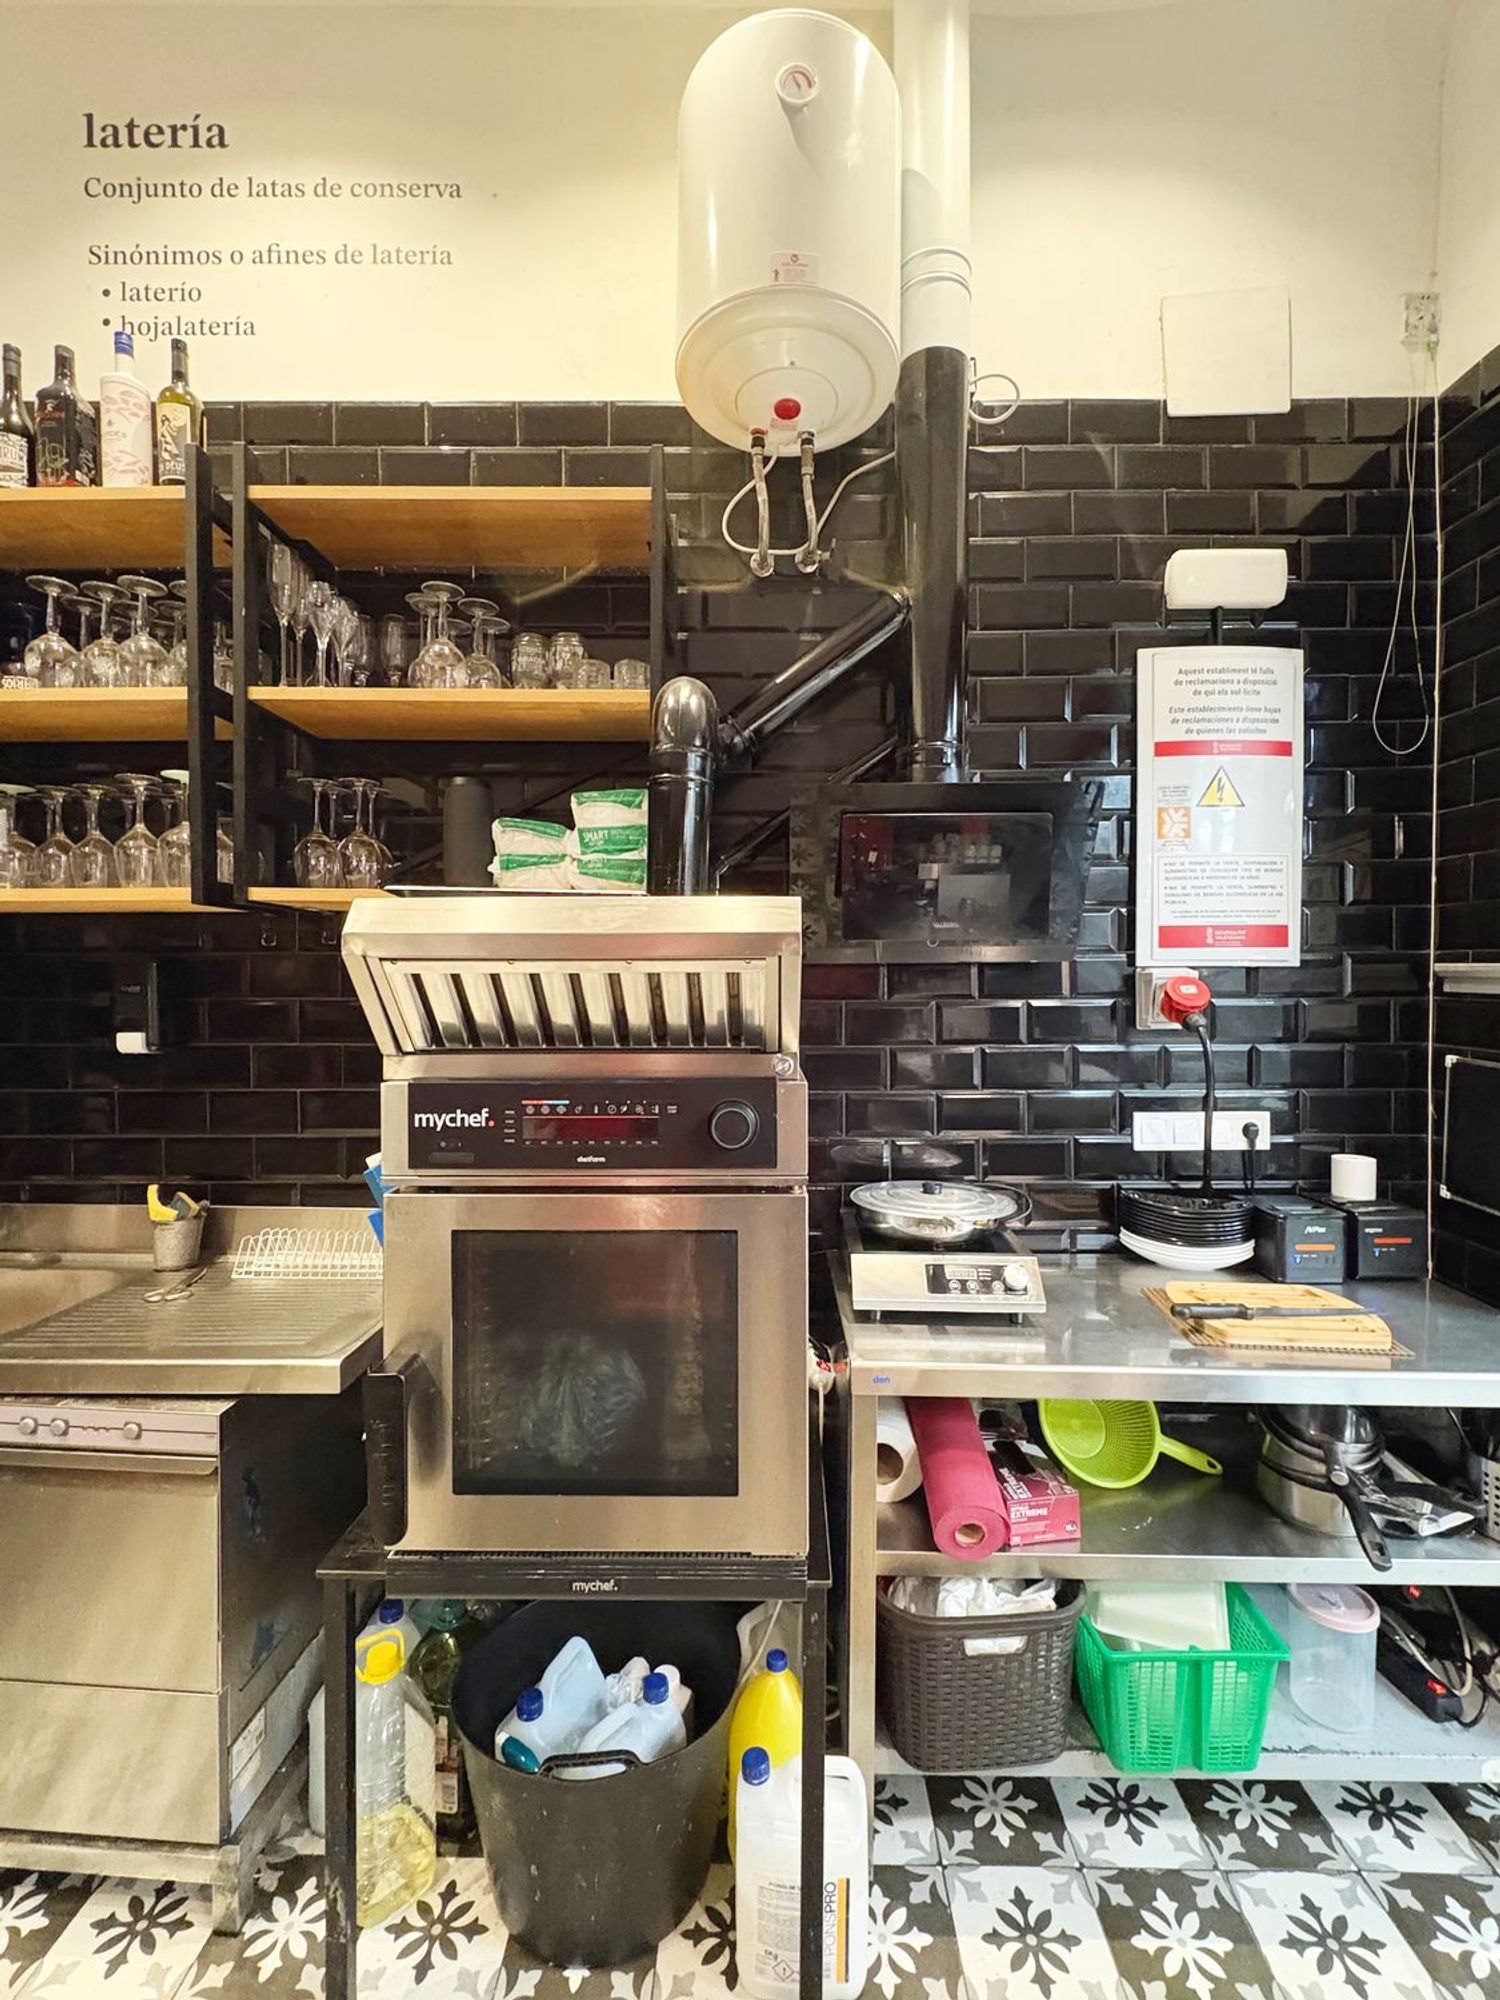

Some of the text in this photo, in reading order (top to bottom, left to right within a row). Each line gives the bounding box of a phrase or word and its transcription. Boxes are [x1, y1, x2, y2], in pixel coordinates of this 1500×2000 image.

[82, 112, 230, 150] latería
[83, 176, 463, 205] Conjunto de latas de conserva
[87, 242, 453, 266] Sinónimos o afines de latería
[119, 280, 202, 303] laterío
[119, 314, 256, 343] hojalatería
[1177, 667, 1205, 677] Aquest
[1173, 678, 1184, 687] de
[1185, 677, 1235, 686] reclamacions
[1192, 688, 1202, 697] de
[1168, 705, 1185, 715] Este
[1170, 716, 1179, 725] de
[1184, 726, 1195, 735] de
[414, 1108, 495, 1132] mychef.
[1010, 1508, 1048, 1519] EXTREME
[573, 1579, 618, 1593] mychef.
